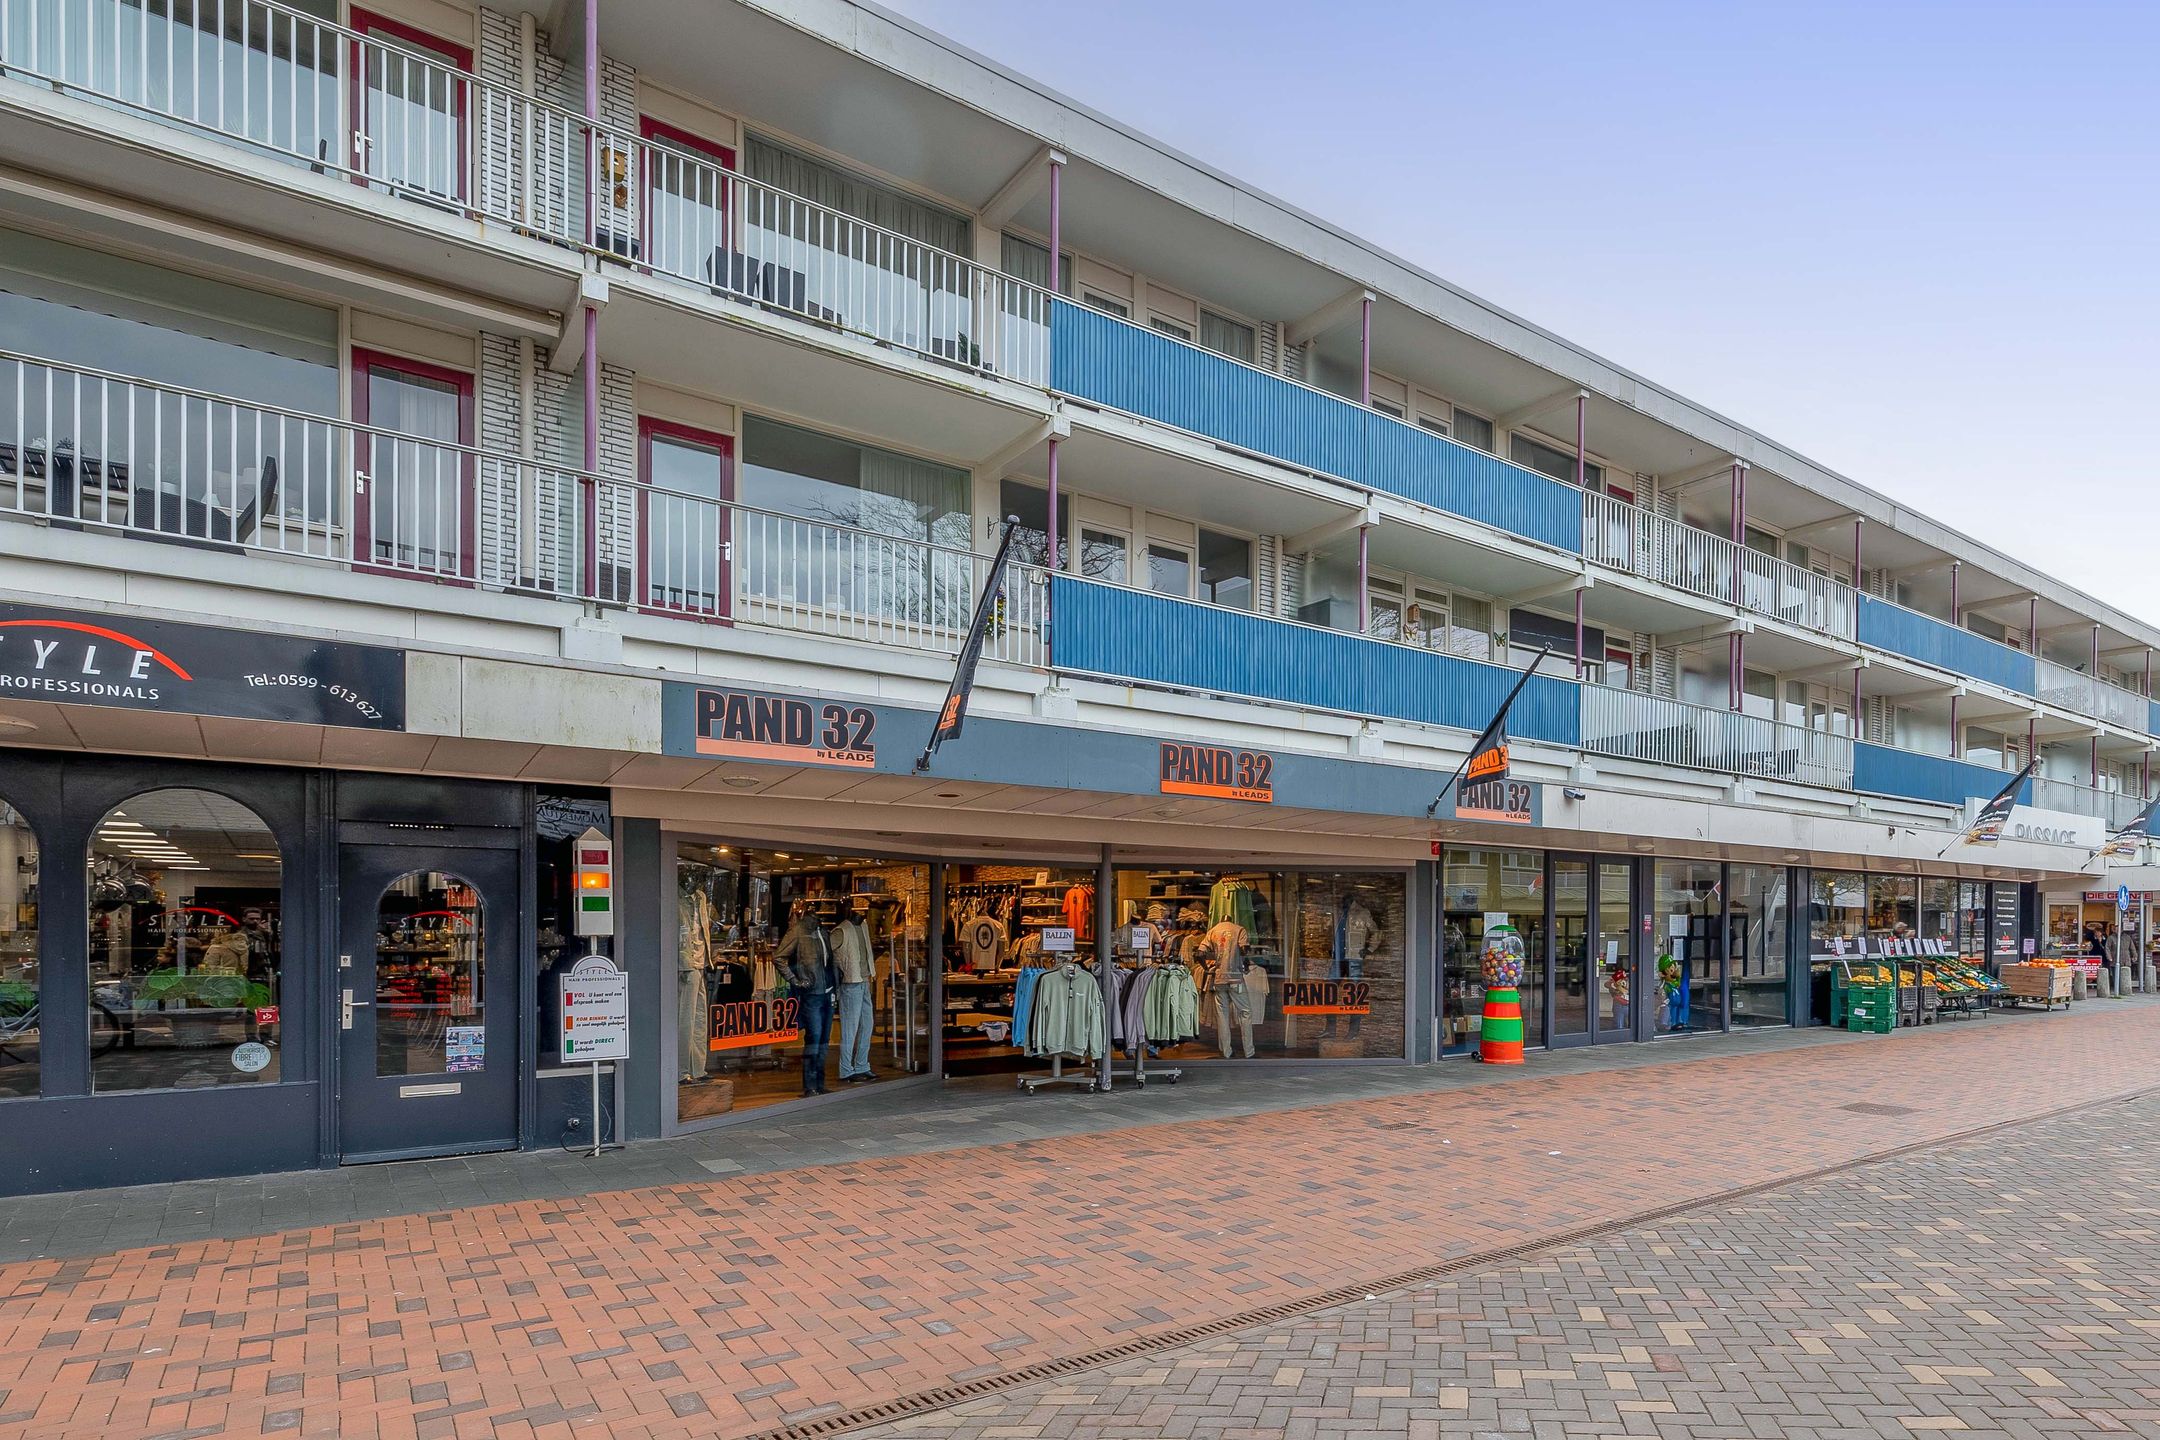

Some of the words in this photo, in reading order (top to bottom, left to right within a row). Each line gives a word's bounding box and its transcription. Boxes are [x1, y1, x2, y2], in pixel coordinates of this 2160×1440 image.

[0, 635, 154, 680] YLE
[279, 673, 318, 688] 0599
[329, 684, 358, 703] 613
[356, 700, 382, 719] 627
[696, 688, 814, 747] PAND
[822, 703, 876, 753] 32
[817, 751, 826, 759] by
[828, 751, 875, 763] LEADS
[1469, 748, 1500, 775] PAND
[1500, 744, 1509, 765] 3
[1161, 742, 1235, 786] PAND
[1237, 751, 1274, 791] 32
[1239, 790, 1269, 800] LEADS
[1508, 782, 1532, 813] 32
[1510, 812, 1531, 820] LEADS
[148, 914, 226, 926] STYLE
[399, 917, 465, 928] STYLE
[1045, 931, 1072, 939] BALLIN
[1133, 930, 1149, 938] BALLIN
[1282, 981, 1339, 1006] PAND
[1342, 981, 1370, 1006] 32
[710, 1000, 768, 1040] PAND
[771, 997, 799, 1033] 32
[774, 1031, 797, 1039] LEADS
